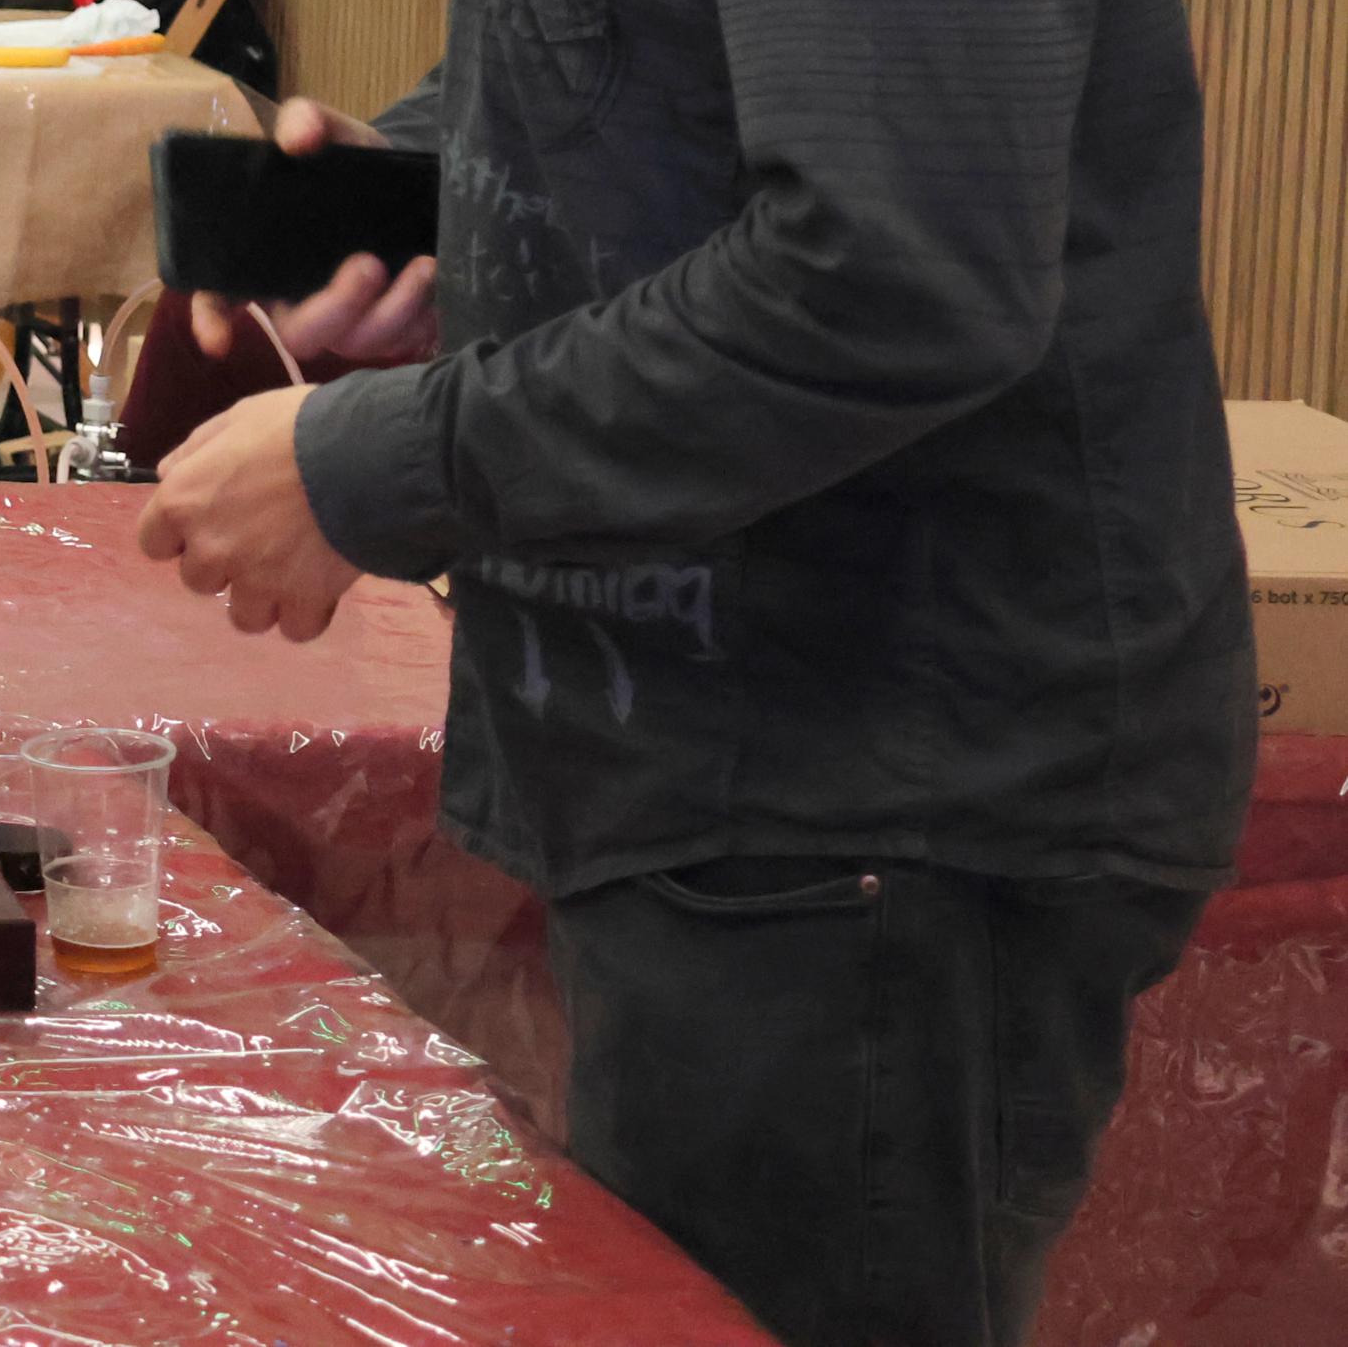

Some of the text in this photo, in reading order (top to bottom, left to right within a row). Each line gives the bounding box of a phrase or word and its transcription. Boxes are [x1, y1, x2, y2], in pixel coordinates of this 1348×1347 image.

[1251, 590, 1263, 605] 6
[1268, 590, 1298, 605] bot
[1304, 594, 1314, 605] x
